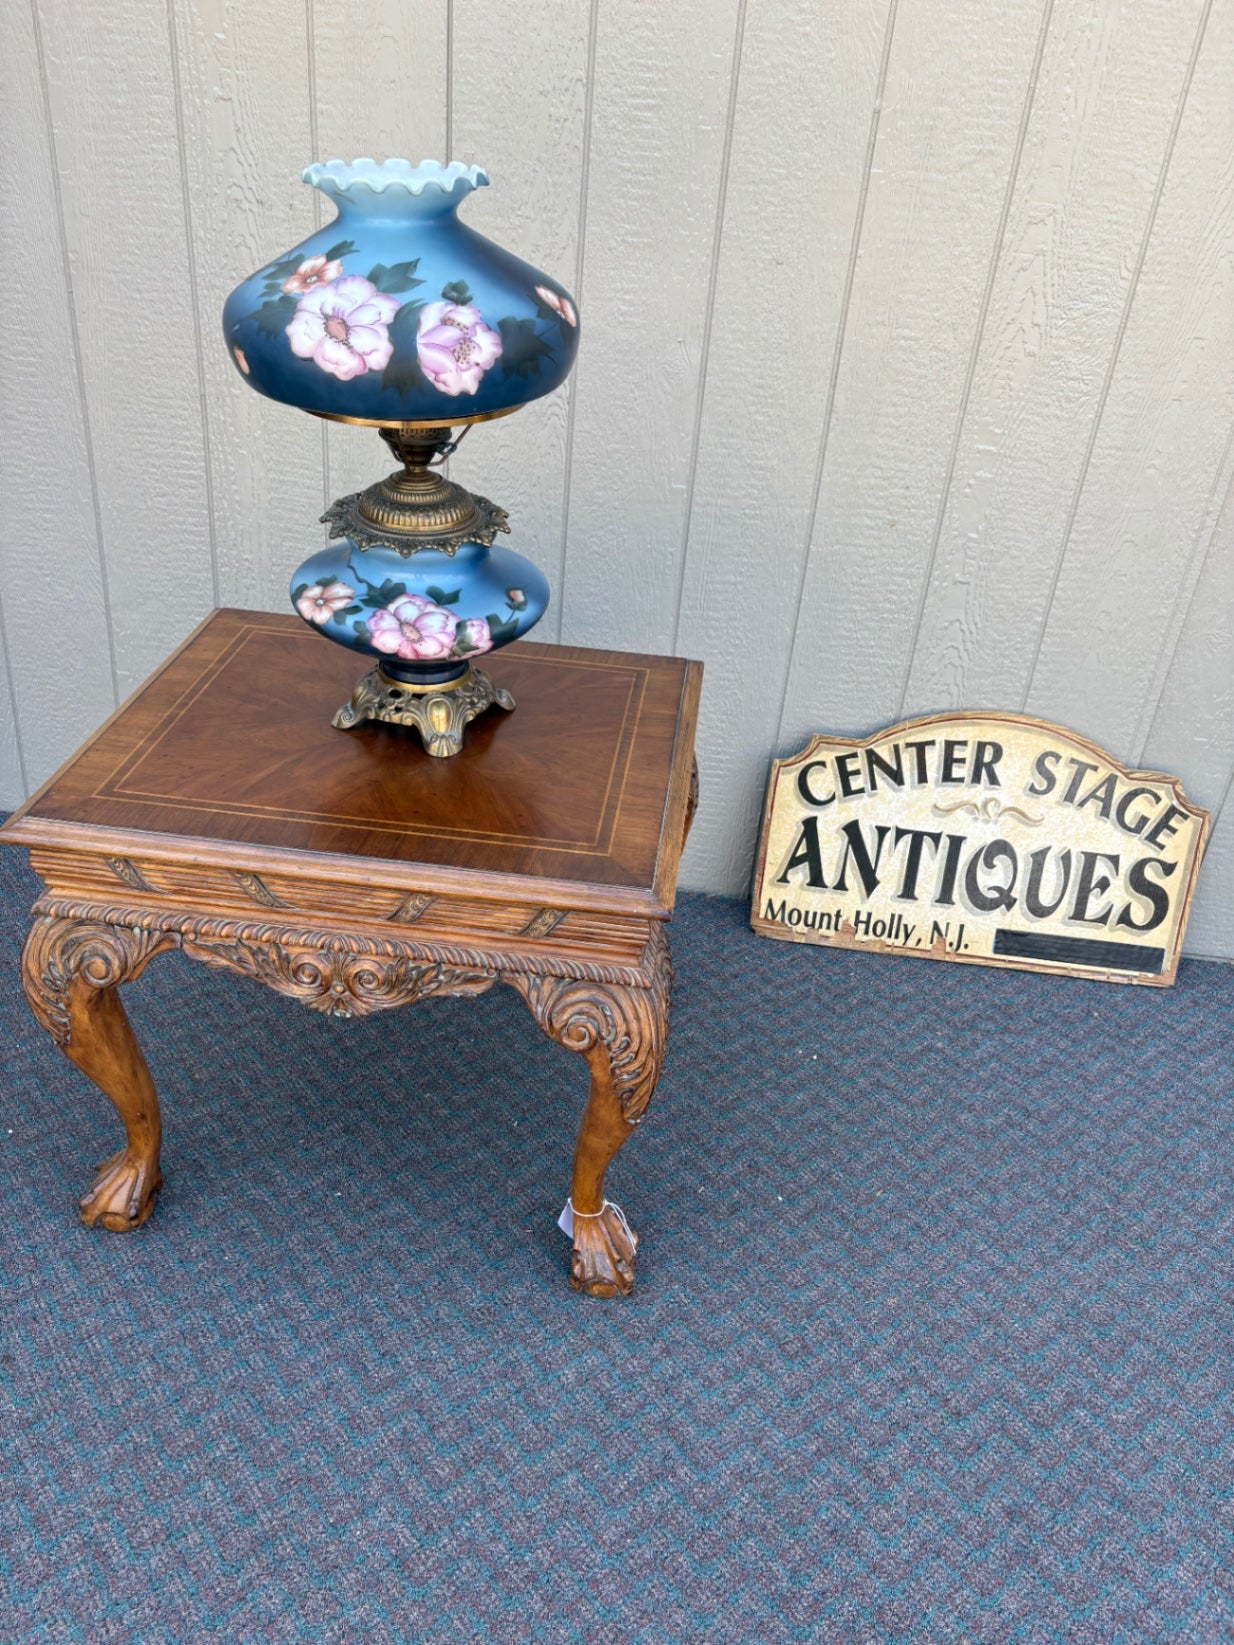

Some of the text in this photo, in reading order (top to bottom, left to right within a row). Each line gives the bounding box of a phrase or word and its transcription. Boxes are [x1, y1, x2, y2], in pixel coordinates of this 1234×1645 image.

[797, 740, 1190, 851] CENTER STAGE
[764, 898, 969, 952] Mount Holly, N.J.
[776, 815, 1178, 931] ANTIQUES
